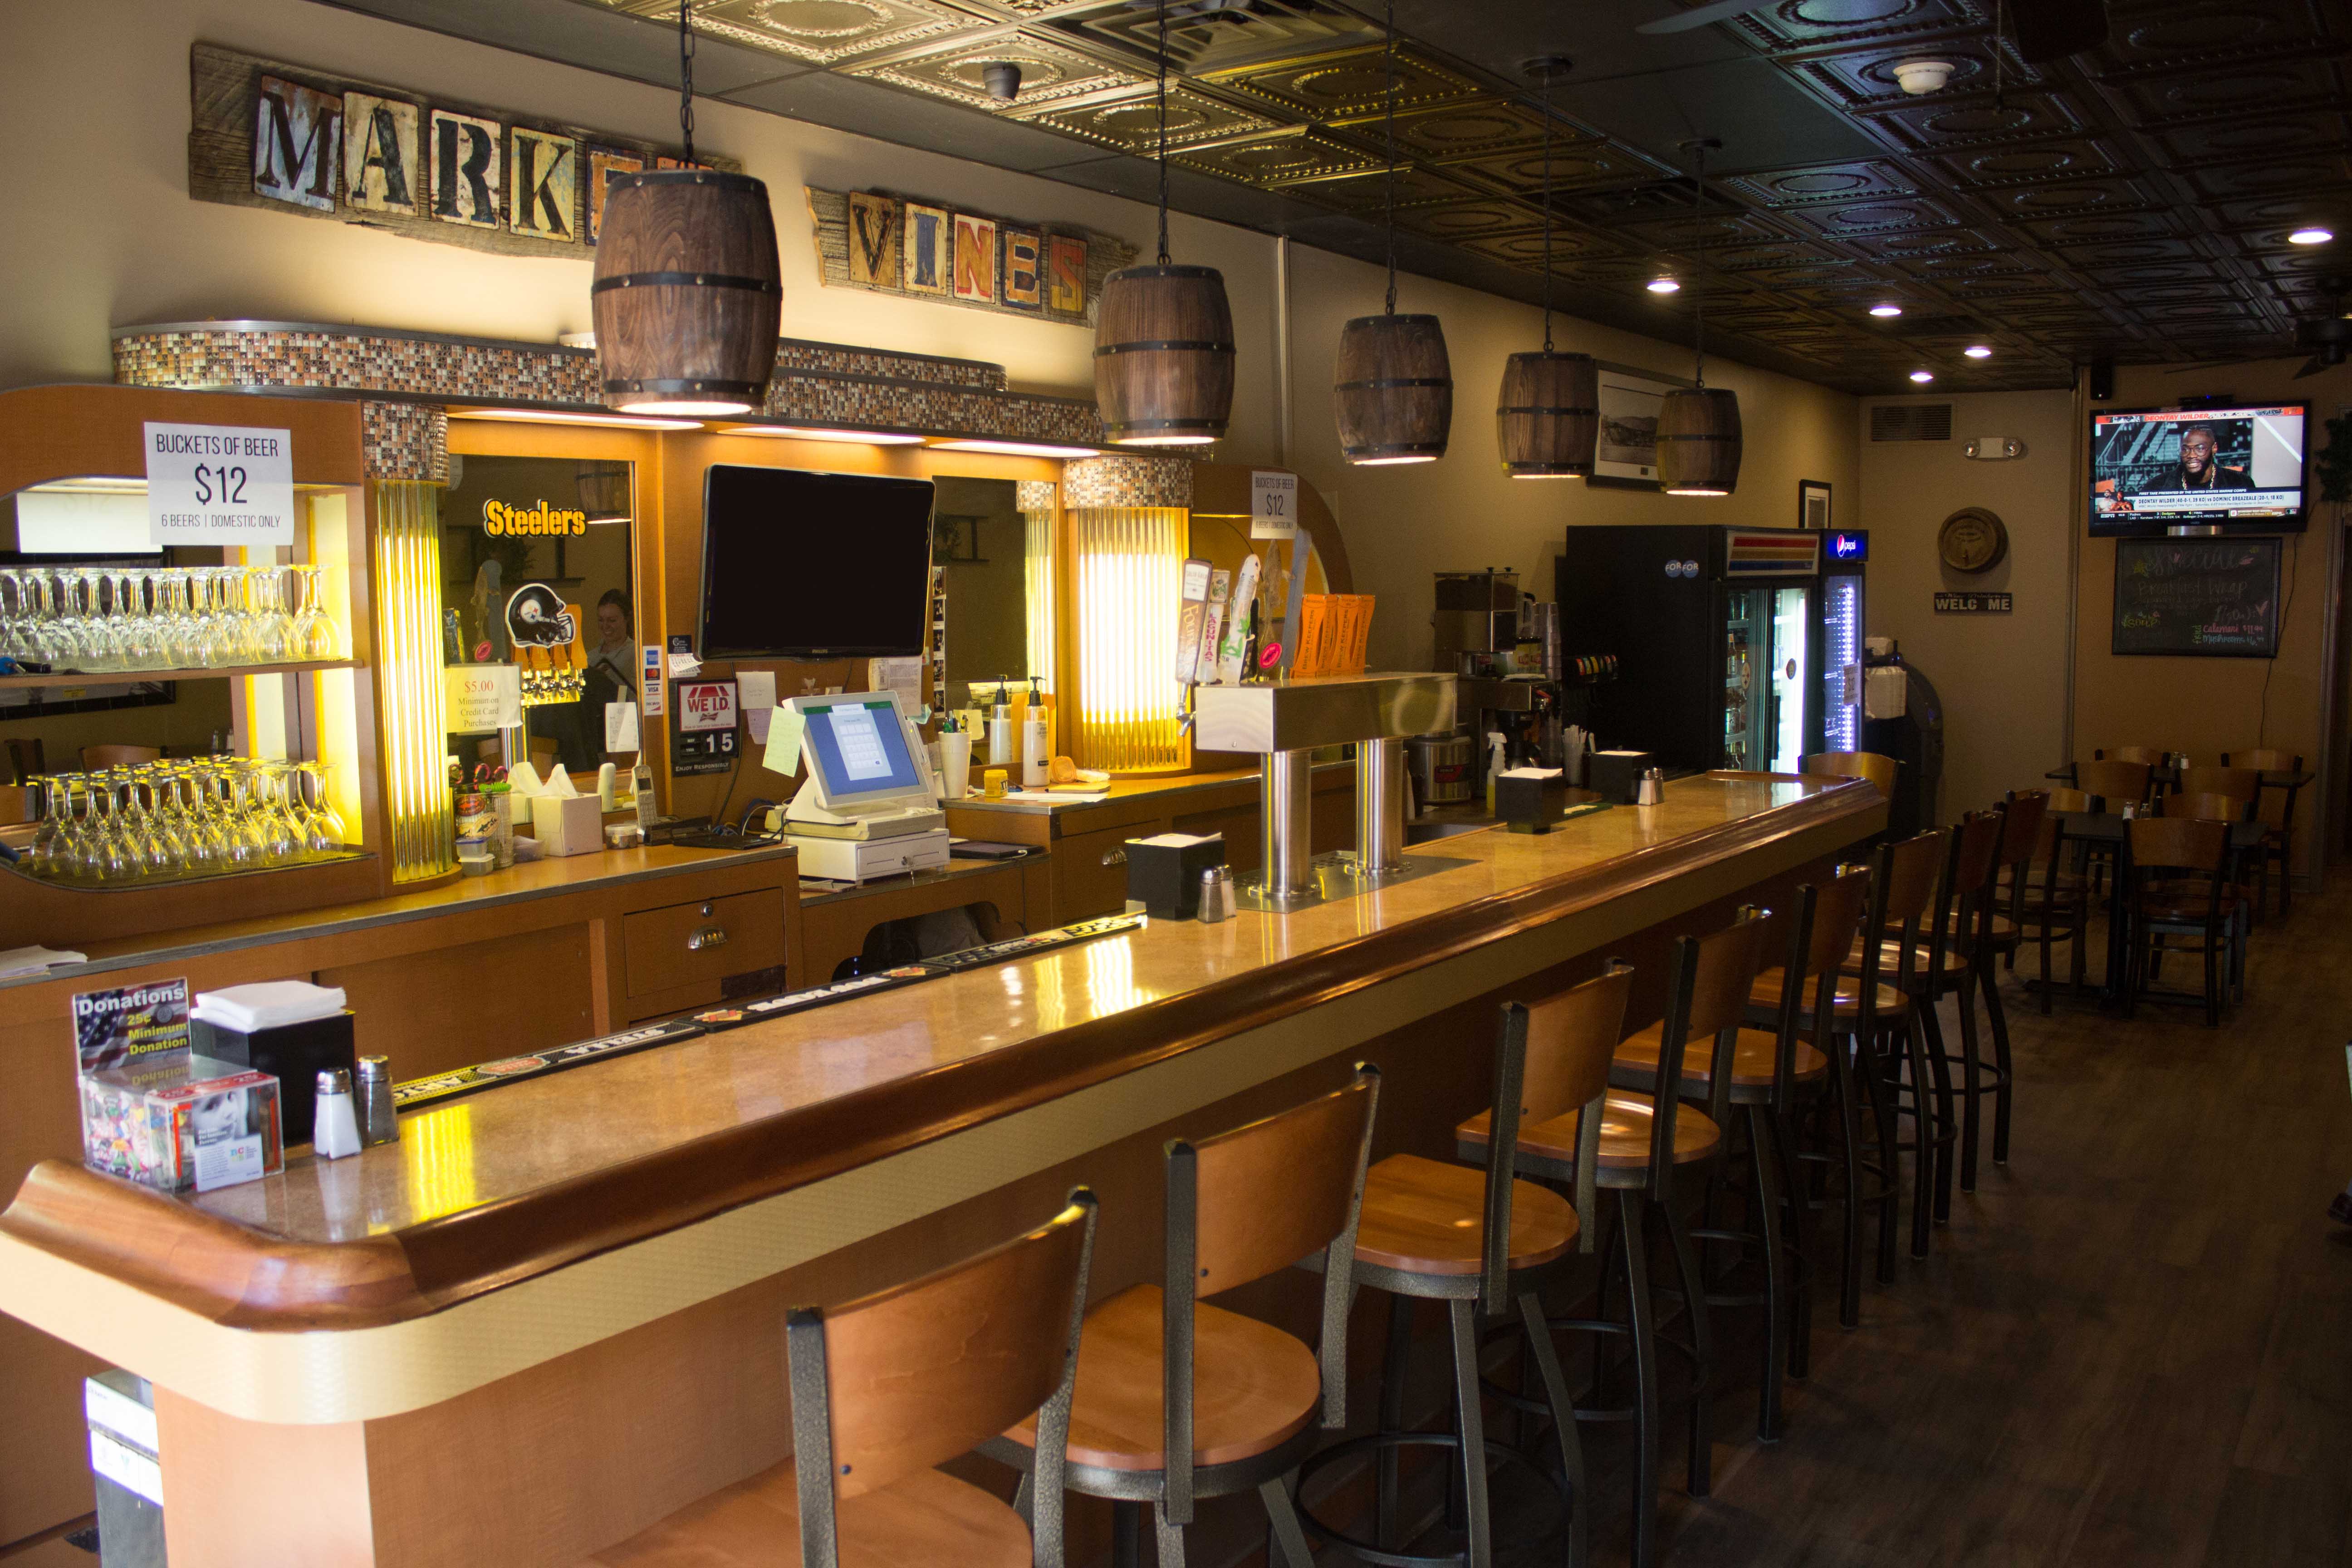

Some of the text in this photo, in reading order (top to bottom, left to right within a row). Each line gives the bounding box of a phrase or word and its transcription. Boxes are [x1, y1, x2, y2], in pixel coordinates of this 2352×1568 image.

[853, 205, 1083, 310] VINES
[157, 434, 279, 457] BUCKETS OF BEER
[195, 463, 248, 506] $12
[1255, 477, 1294, 490] BUCKETS OF BEER
[1267, 493, 1284, 516] $12
[162, 514, 280, 528] 6 BEERS DOMESTIC ONLY
[485, 500, 586, 536] Steelers
[1844, 540, 1856, 552] pepsi
[1665, 561, 1681, 572] FOR
[1682, 562, 1699, 572] FOR
[1205, 613, 1216, 662] LAGUNITAS
[465, 680, 494, 693] $5.00
[687, 697, 730, 713] WE I.D.
[464, 719, 496, 727] Purchases
[706, 733, 734, 753] 15
[694, 762, 729, 770] RESPONSIBLY
[79, 988, 185, 1015] Donations
[127, 1014, 152, 1025] 25¢
[128, 1023, 186, 1040] Minimum
[130, 1037, 187, 1055] Donation
